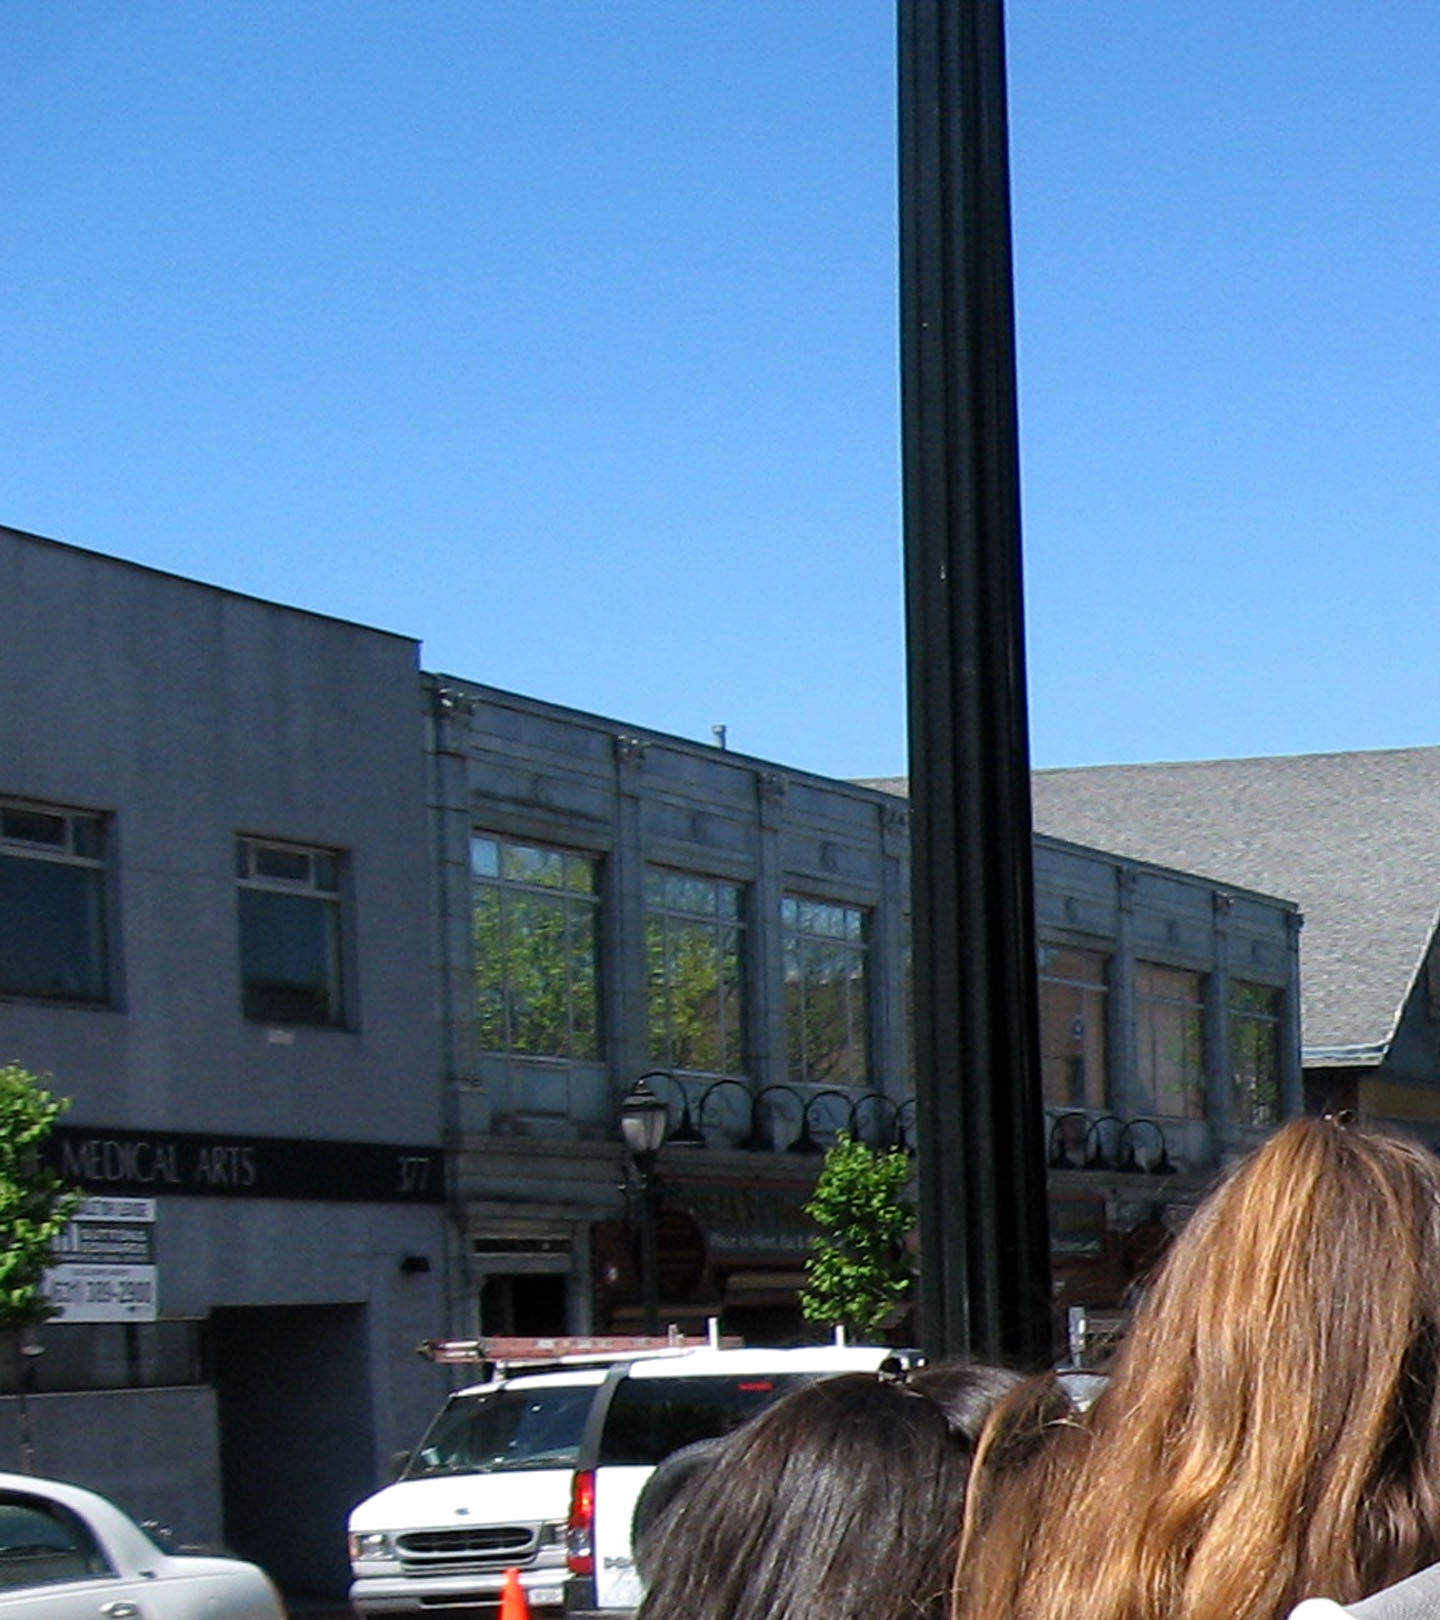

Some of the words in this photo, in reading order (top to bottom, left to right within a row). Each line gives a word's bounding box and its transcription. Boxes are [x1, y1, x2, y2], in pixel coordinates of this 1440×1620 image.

[60, 1138, 181, 1184] MEDICAL
[196, 1146, 257, 1187] ARTS
[396, 1156, 432, 1193] 377
